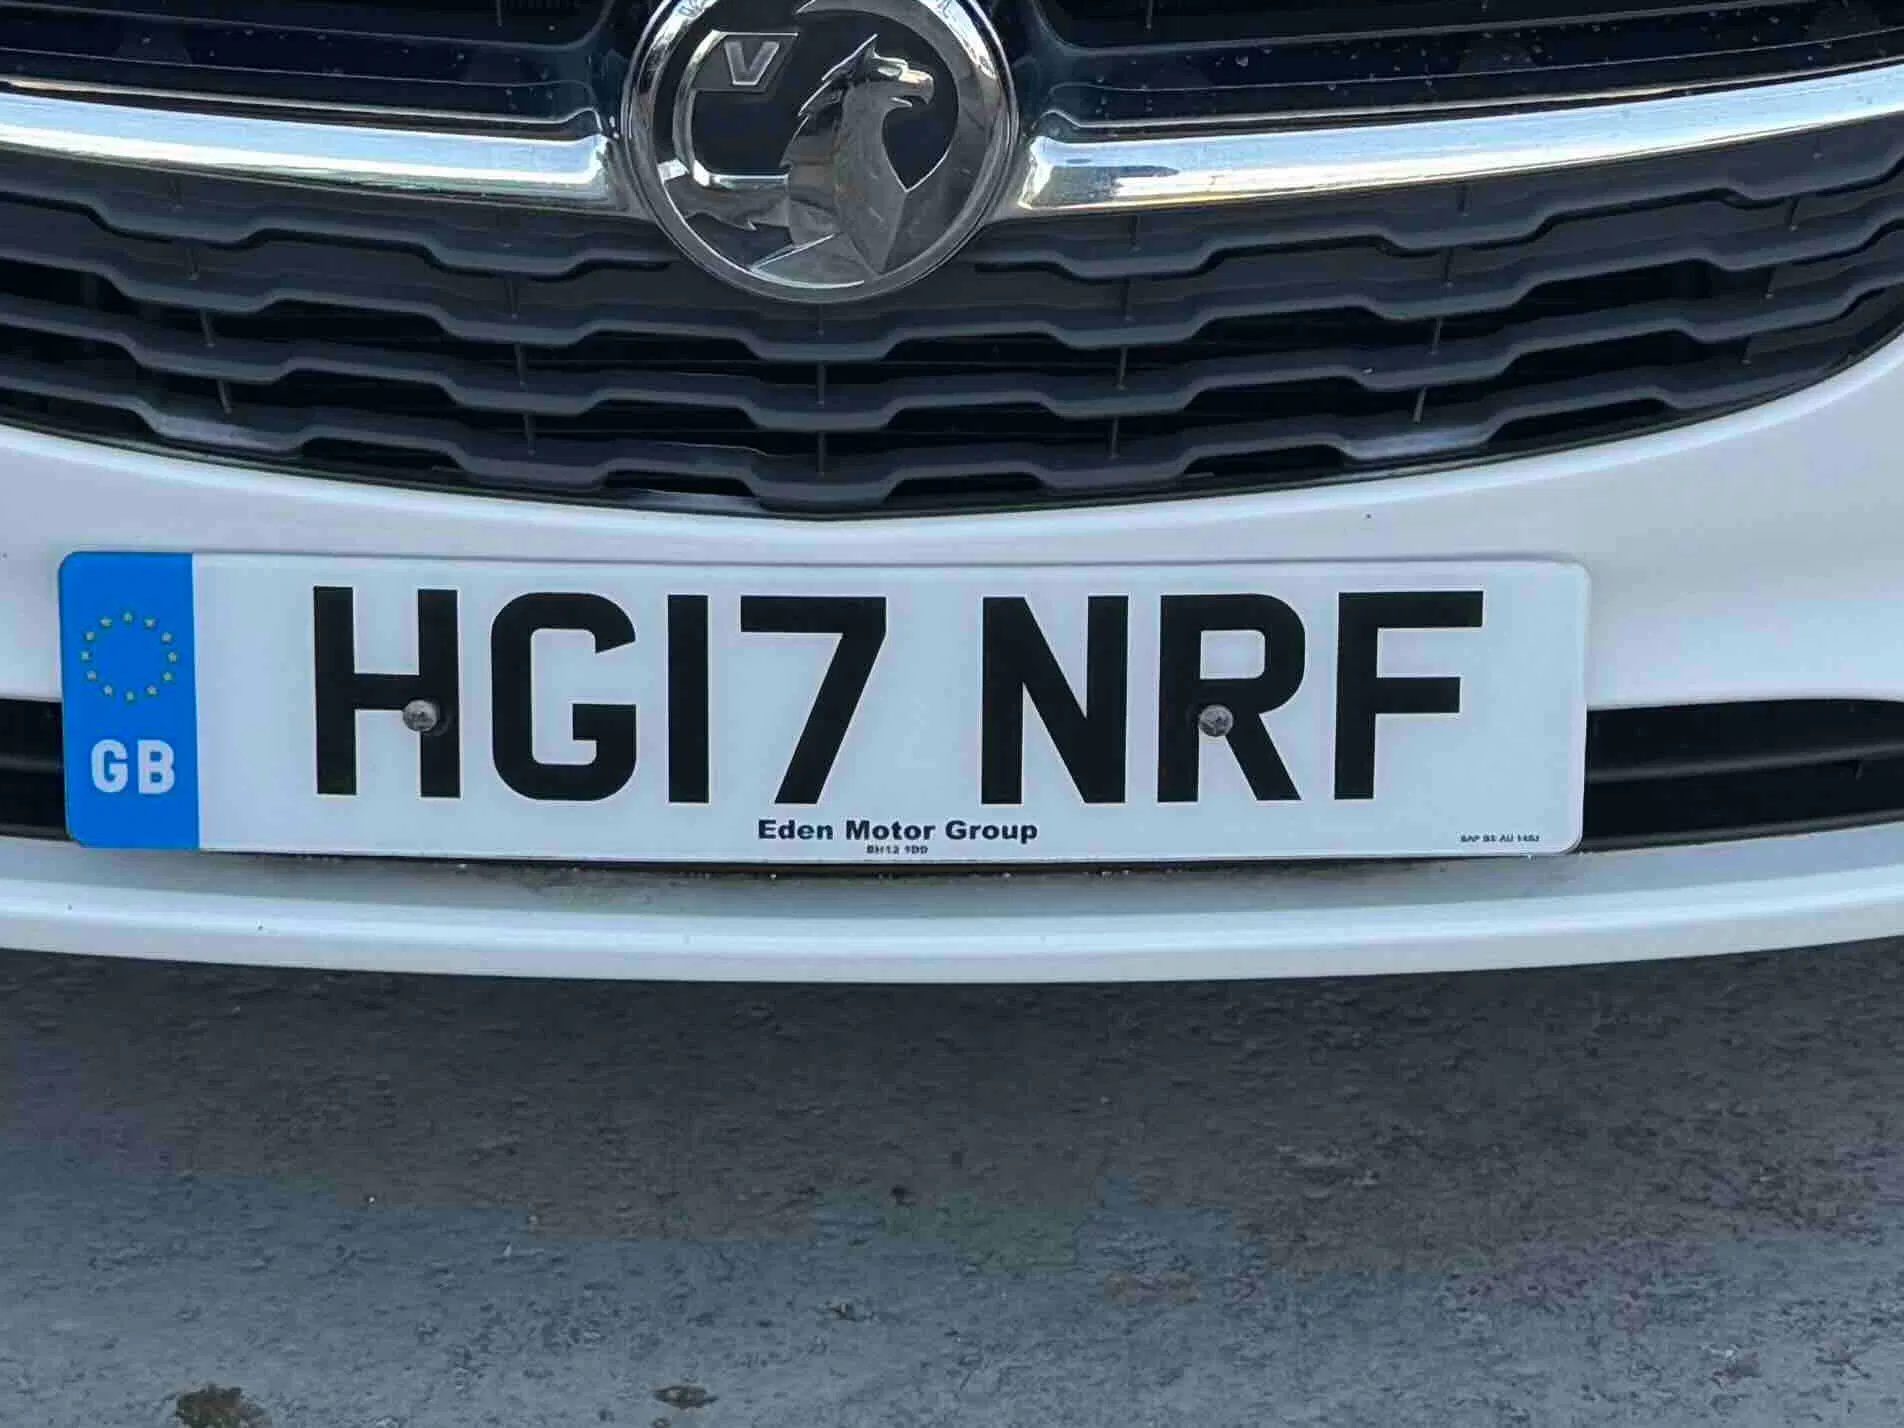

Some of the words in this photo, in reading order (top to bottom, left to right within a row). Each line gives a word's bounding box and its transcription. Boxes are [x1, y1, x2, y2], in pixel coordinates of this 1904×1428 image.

[313, 585, 889, 805] HG17
[981, 590, 1485, 806] NRF
[90, 741, 175, 797] GB
[757, 819, 834, 841] Eden
[845, 819, 937, 842] Motor
[944, 819, 1039, 845] Group
